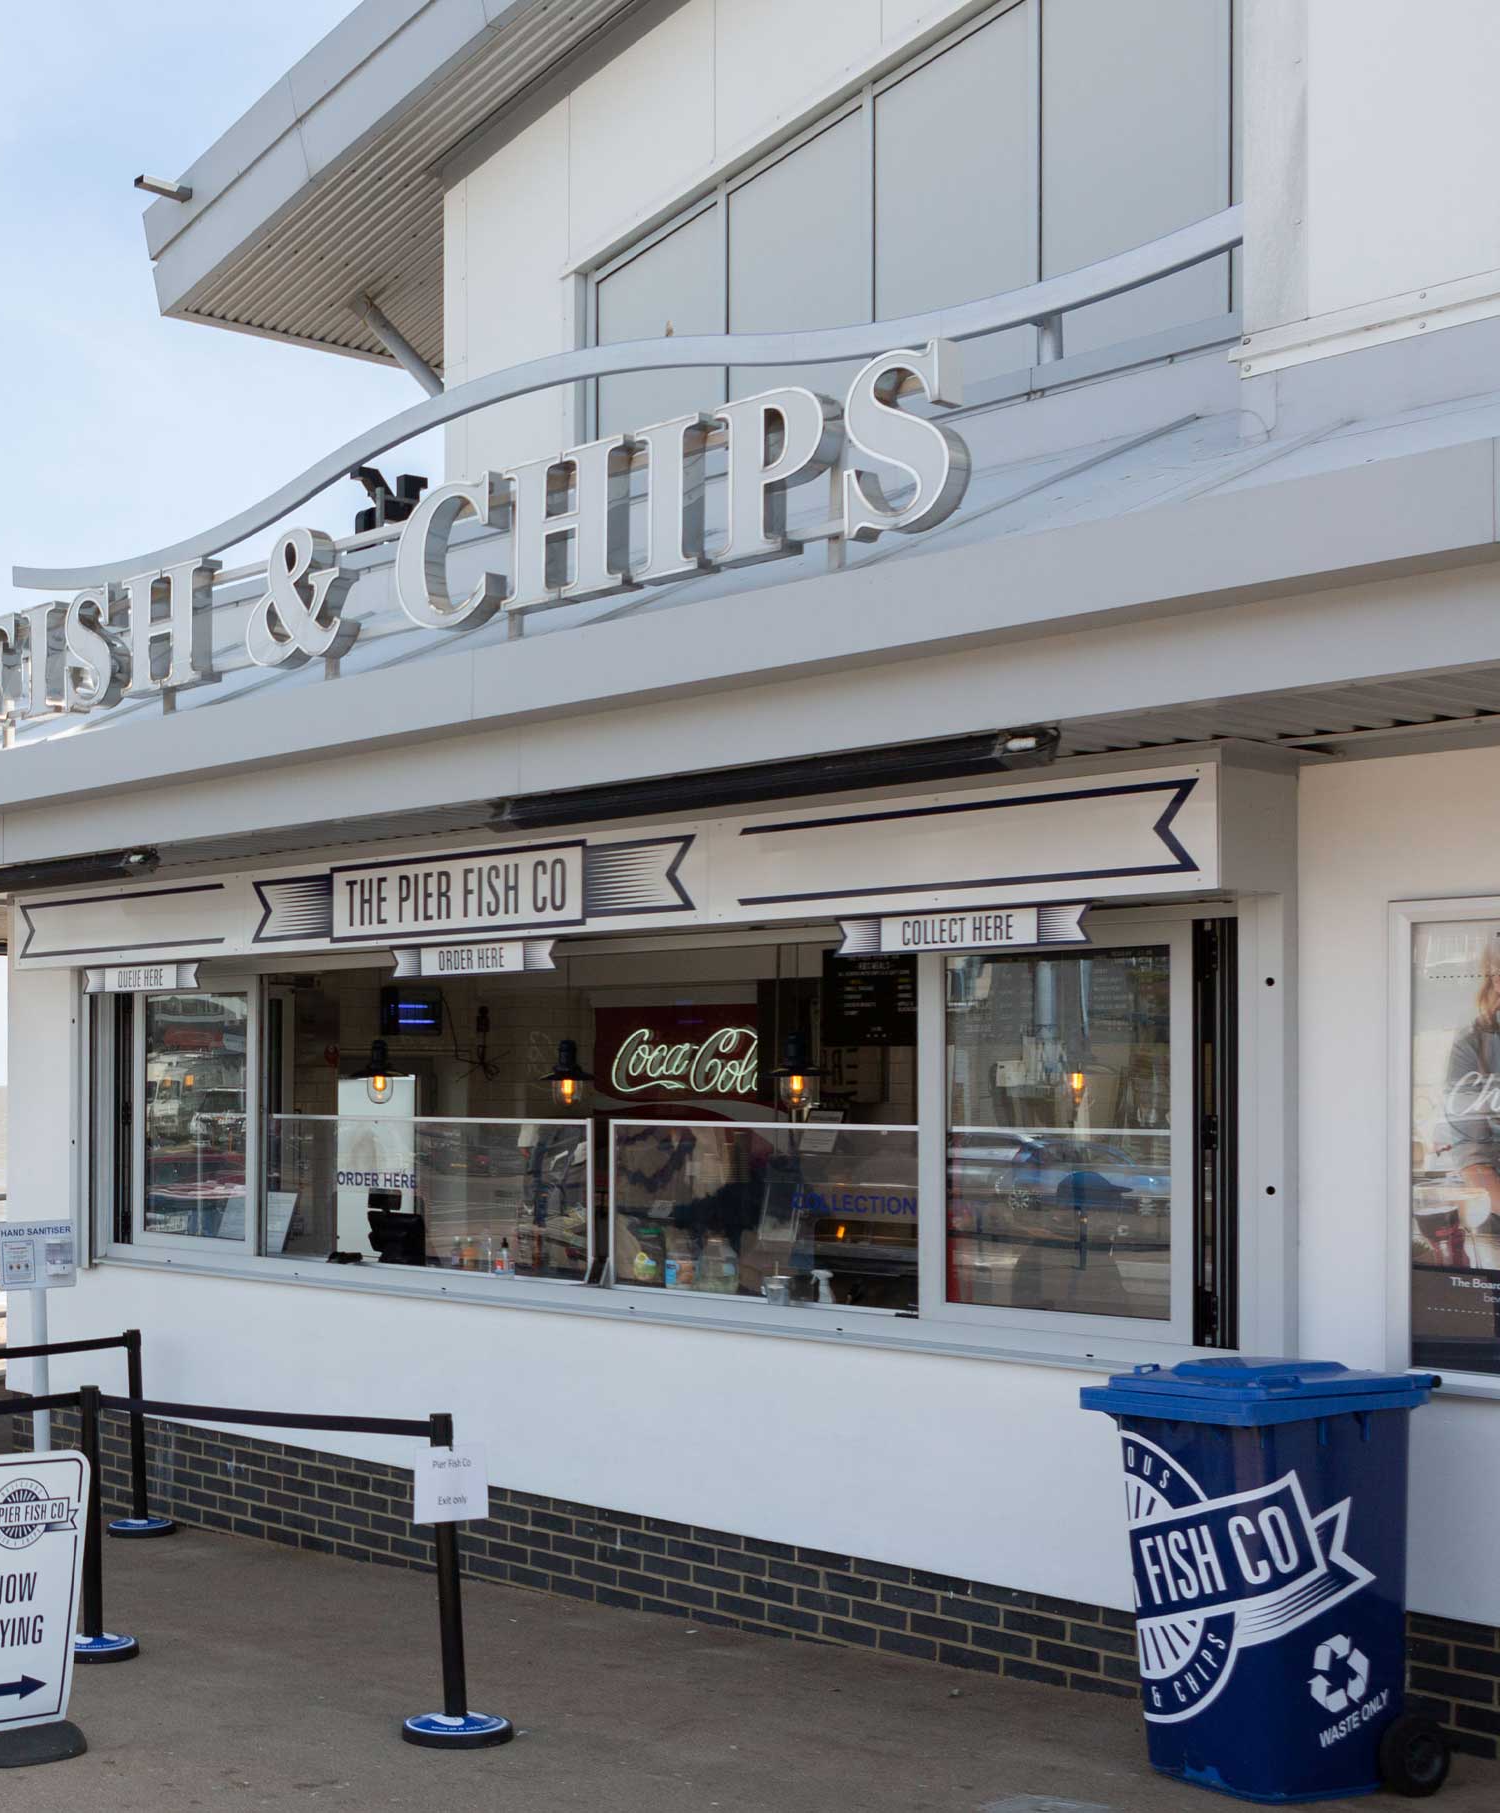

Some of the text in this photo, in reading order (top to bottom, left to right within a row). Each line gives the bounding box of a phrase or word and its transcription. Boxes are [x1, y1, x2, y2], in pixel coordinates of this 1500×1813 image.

[246, 527, 361, 669] &
[396, 338, 971, 631] CHIPS
[346, 858, 567, 927] THE PIER FISH CO
[902, 914, 1014, 946] COLLECT HERE
[438, 947, 505, 971] ORDER HERE
[117, 968, 164, 988] QUEUE HERE
[612, 1028, 758, 1094] Coca-Col
[337, 1171, 418, 1189] ORDER HERE
[0, 1226, 72, 1238] HAND SANITISER
[1449, 1276, 1471, 1288] The
[1127, 1446, 1170, 1489] OUS
[25, 1503, 47, 1521] FISH
[50, 1502, 64, 1519] CO
[438, 1496, 452, 1505] Exit
[1139, 1525, 1228, 1605] FISH
[1228, 1505, 1299, 1585] CO
[1173, 1632, 1226, 1703] CHIPS
[1319, 1688, 1390, 1748] WASTE ONLY
